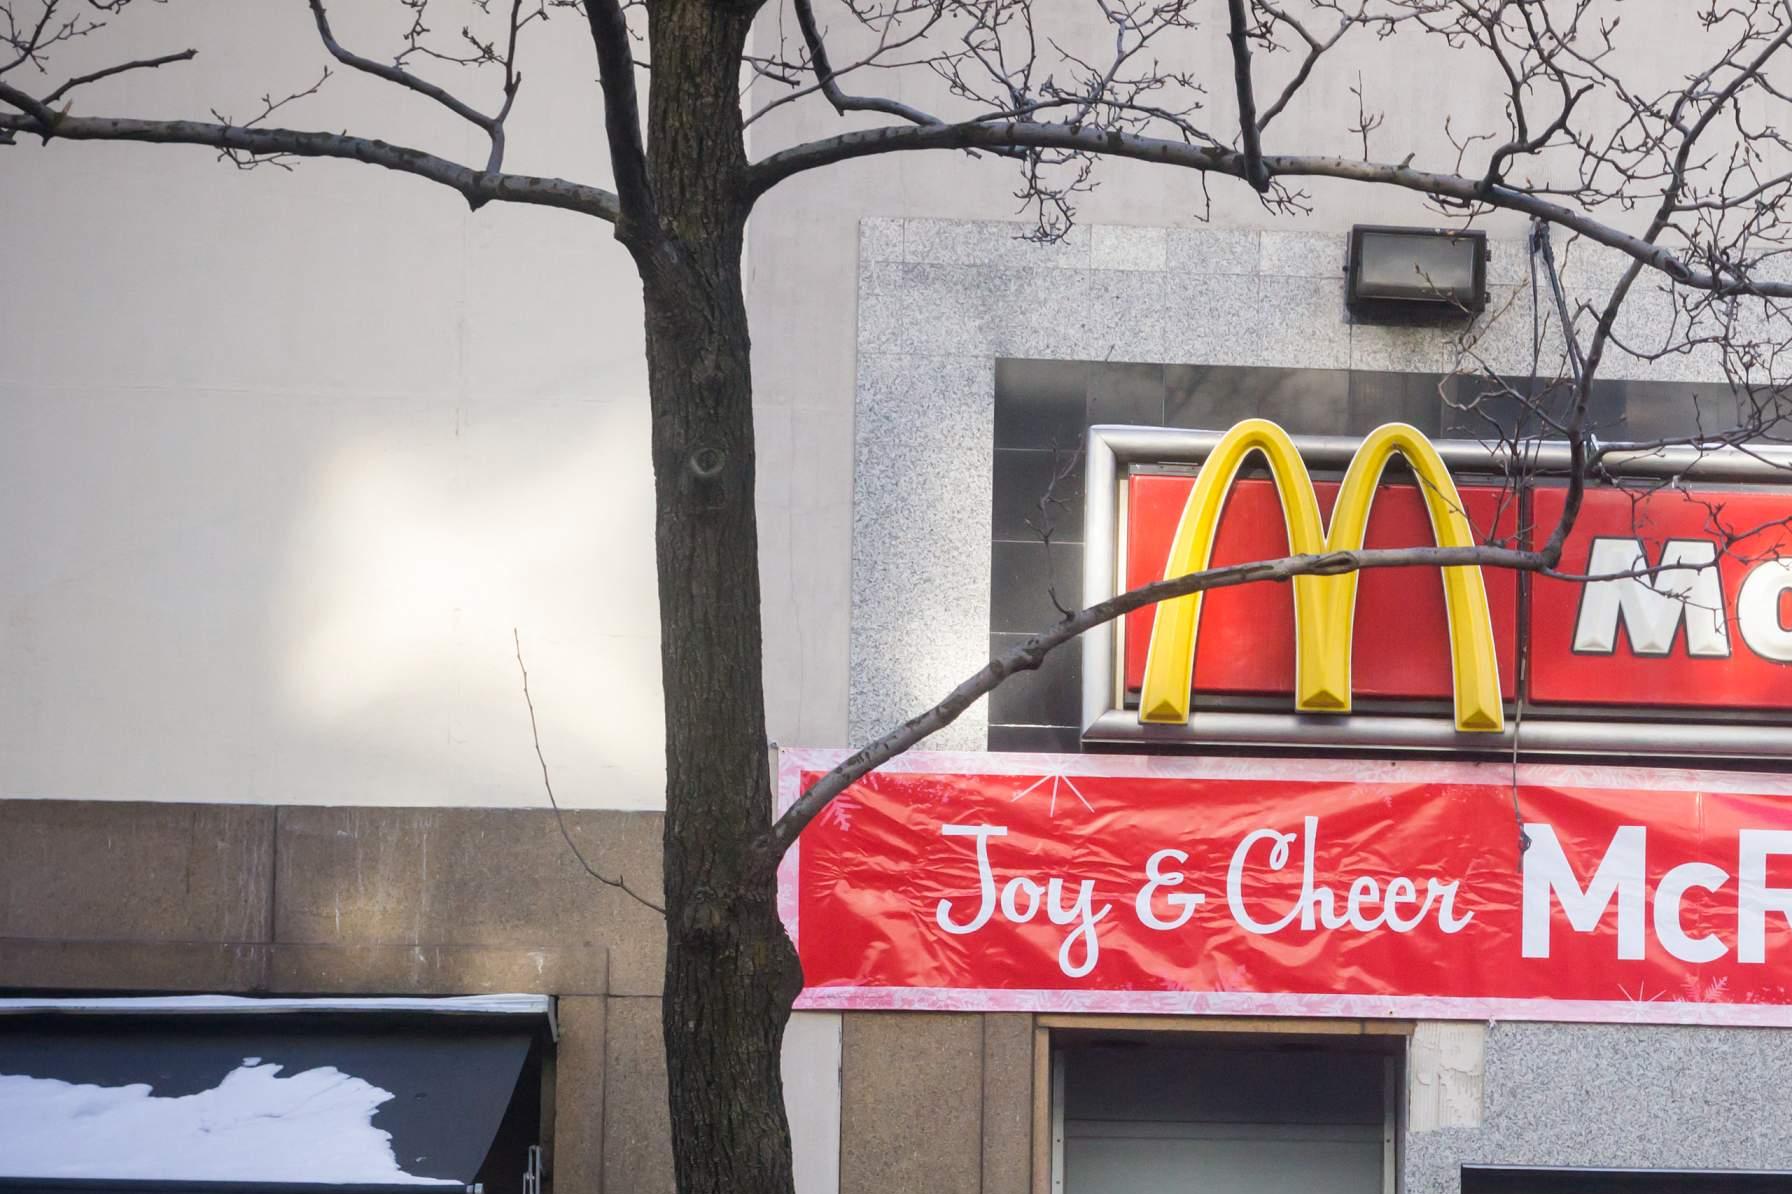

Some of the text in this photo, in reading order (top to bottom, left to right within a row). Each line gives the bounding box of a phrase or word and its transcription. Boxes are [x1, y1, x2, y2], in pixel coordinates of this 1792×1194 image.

[936, 816, 1474, 977] Joy & Cheer
